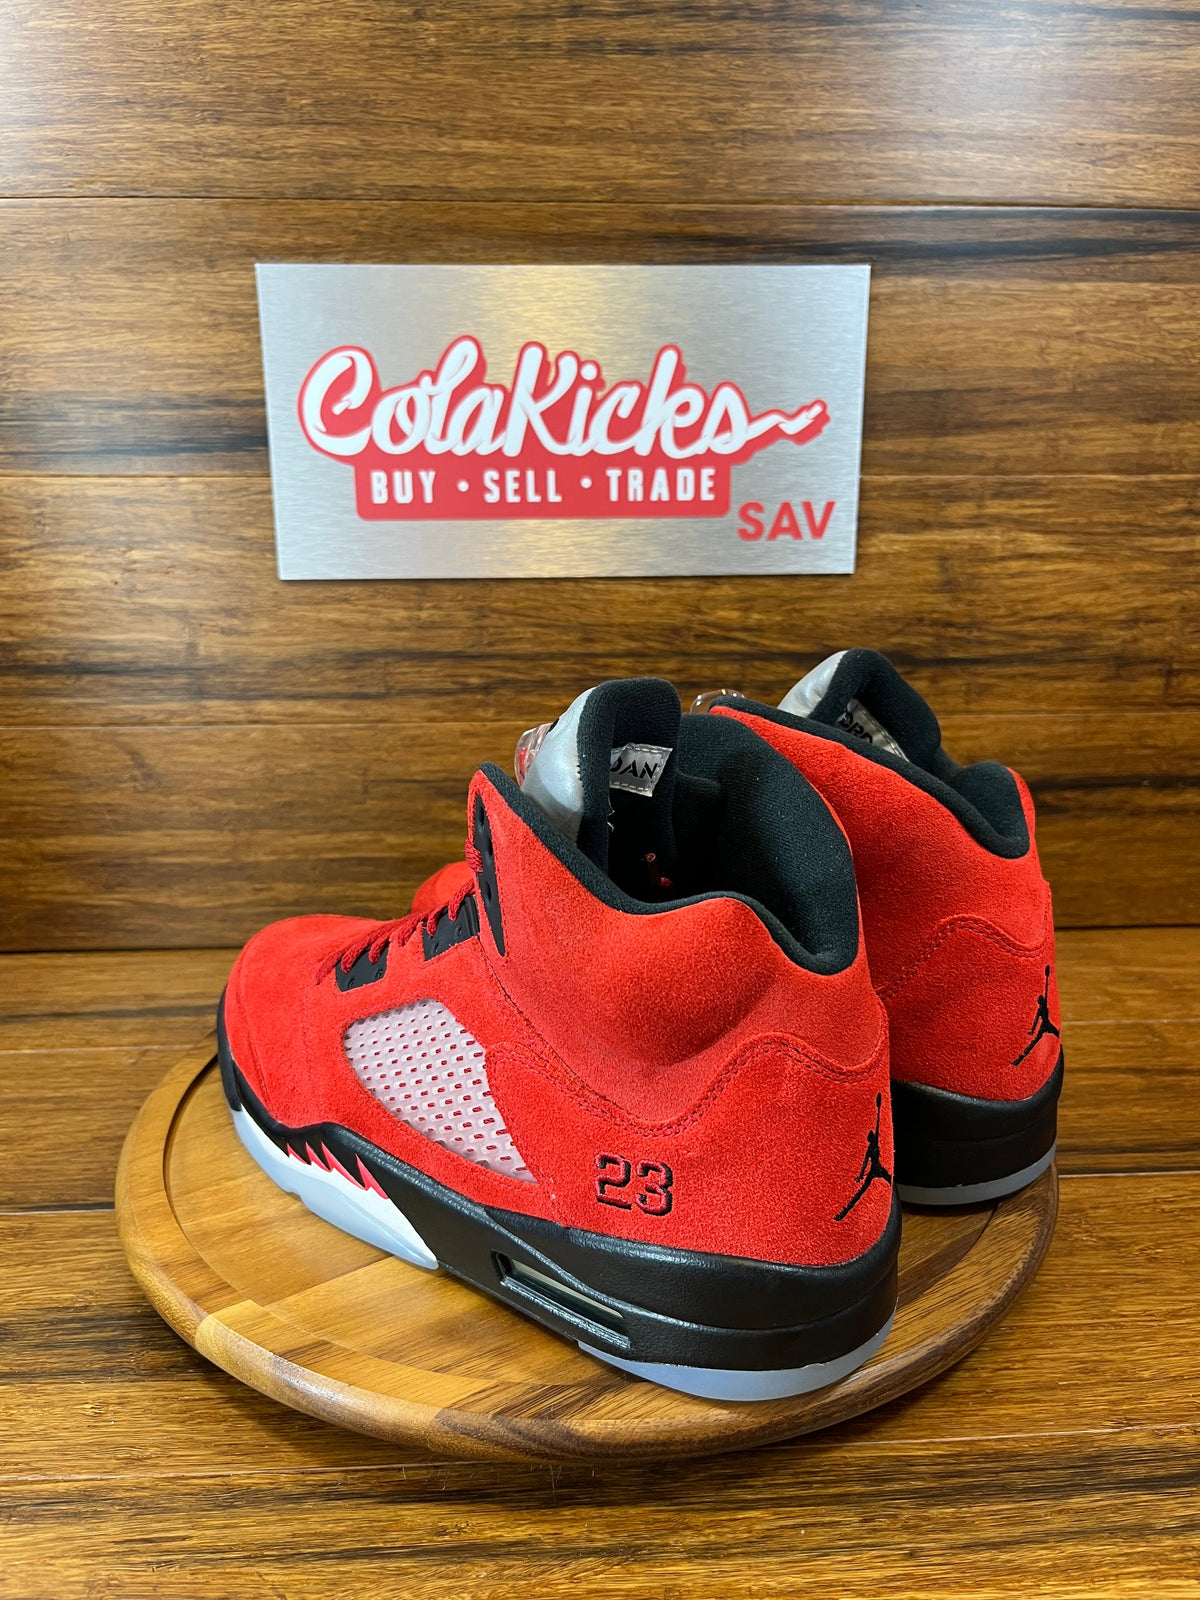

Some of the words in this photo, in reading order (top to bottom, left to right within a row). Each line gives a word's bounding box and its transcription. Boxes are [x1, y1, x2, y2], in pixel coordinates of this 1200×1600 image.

[302, 338, 824, 460] ColaKicks
[370, 470, 436, 504] BUY
[483, 470, 562, 504] SELL
[606, 468, 716, 502] TRADE
[737, 501, 835, 542] SAV
[595, 1151, 674, 1217] 23
